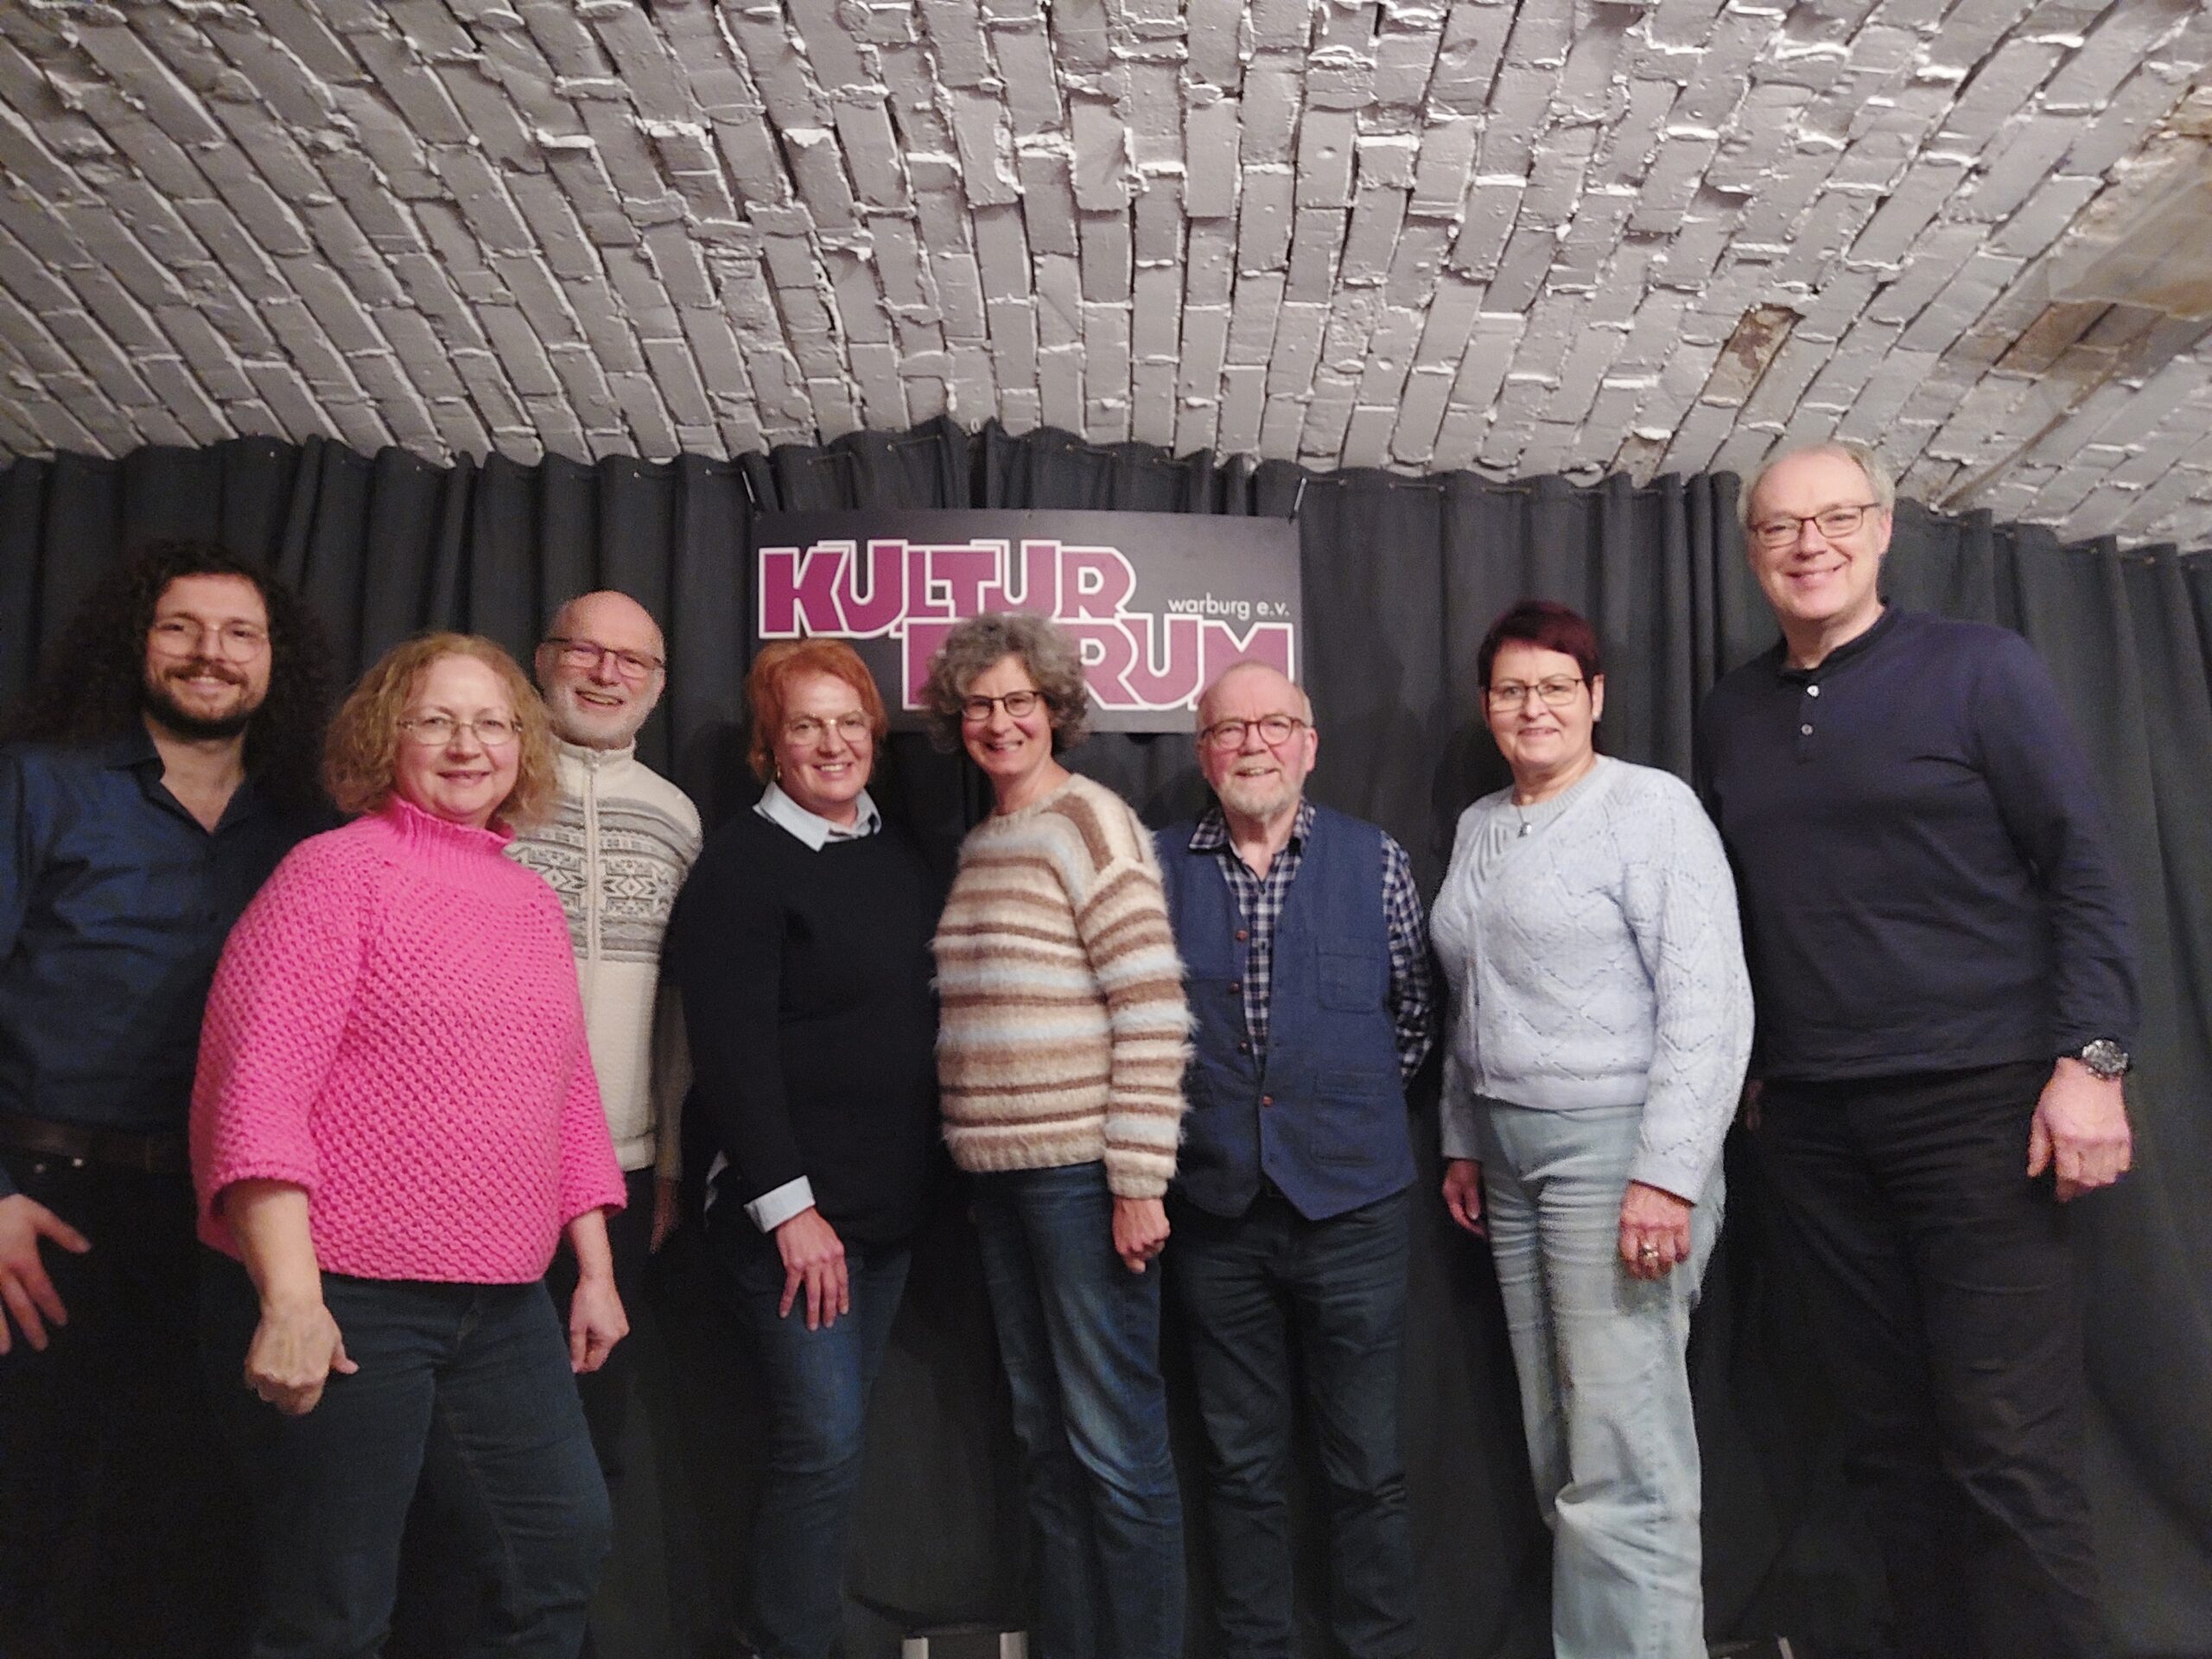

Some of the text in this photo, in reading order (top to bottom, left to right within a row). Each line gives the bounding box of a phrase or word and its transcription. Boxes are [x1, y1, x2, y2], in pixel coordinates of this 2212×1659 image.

[759, 539, 1137, 639] KULTUR
[1167, 592, 1290, 620] warburg e.v.
